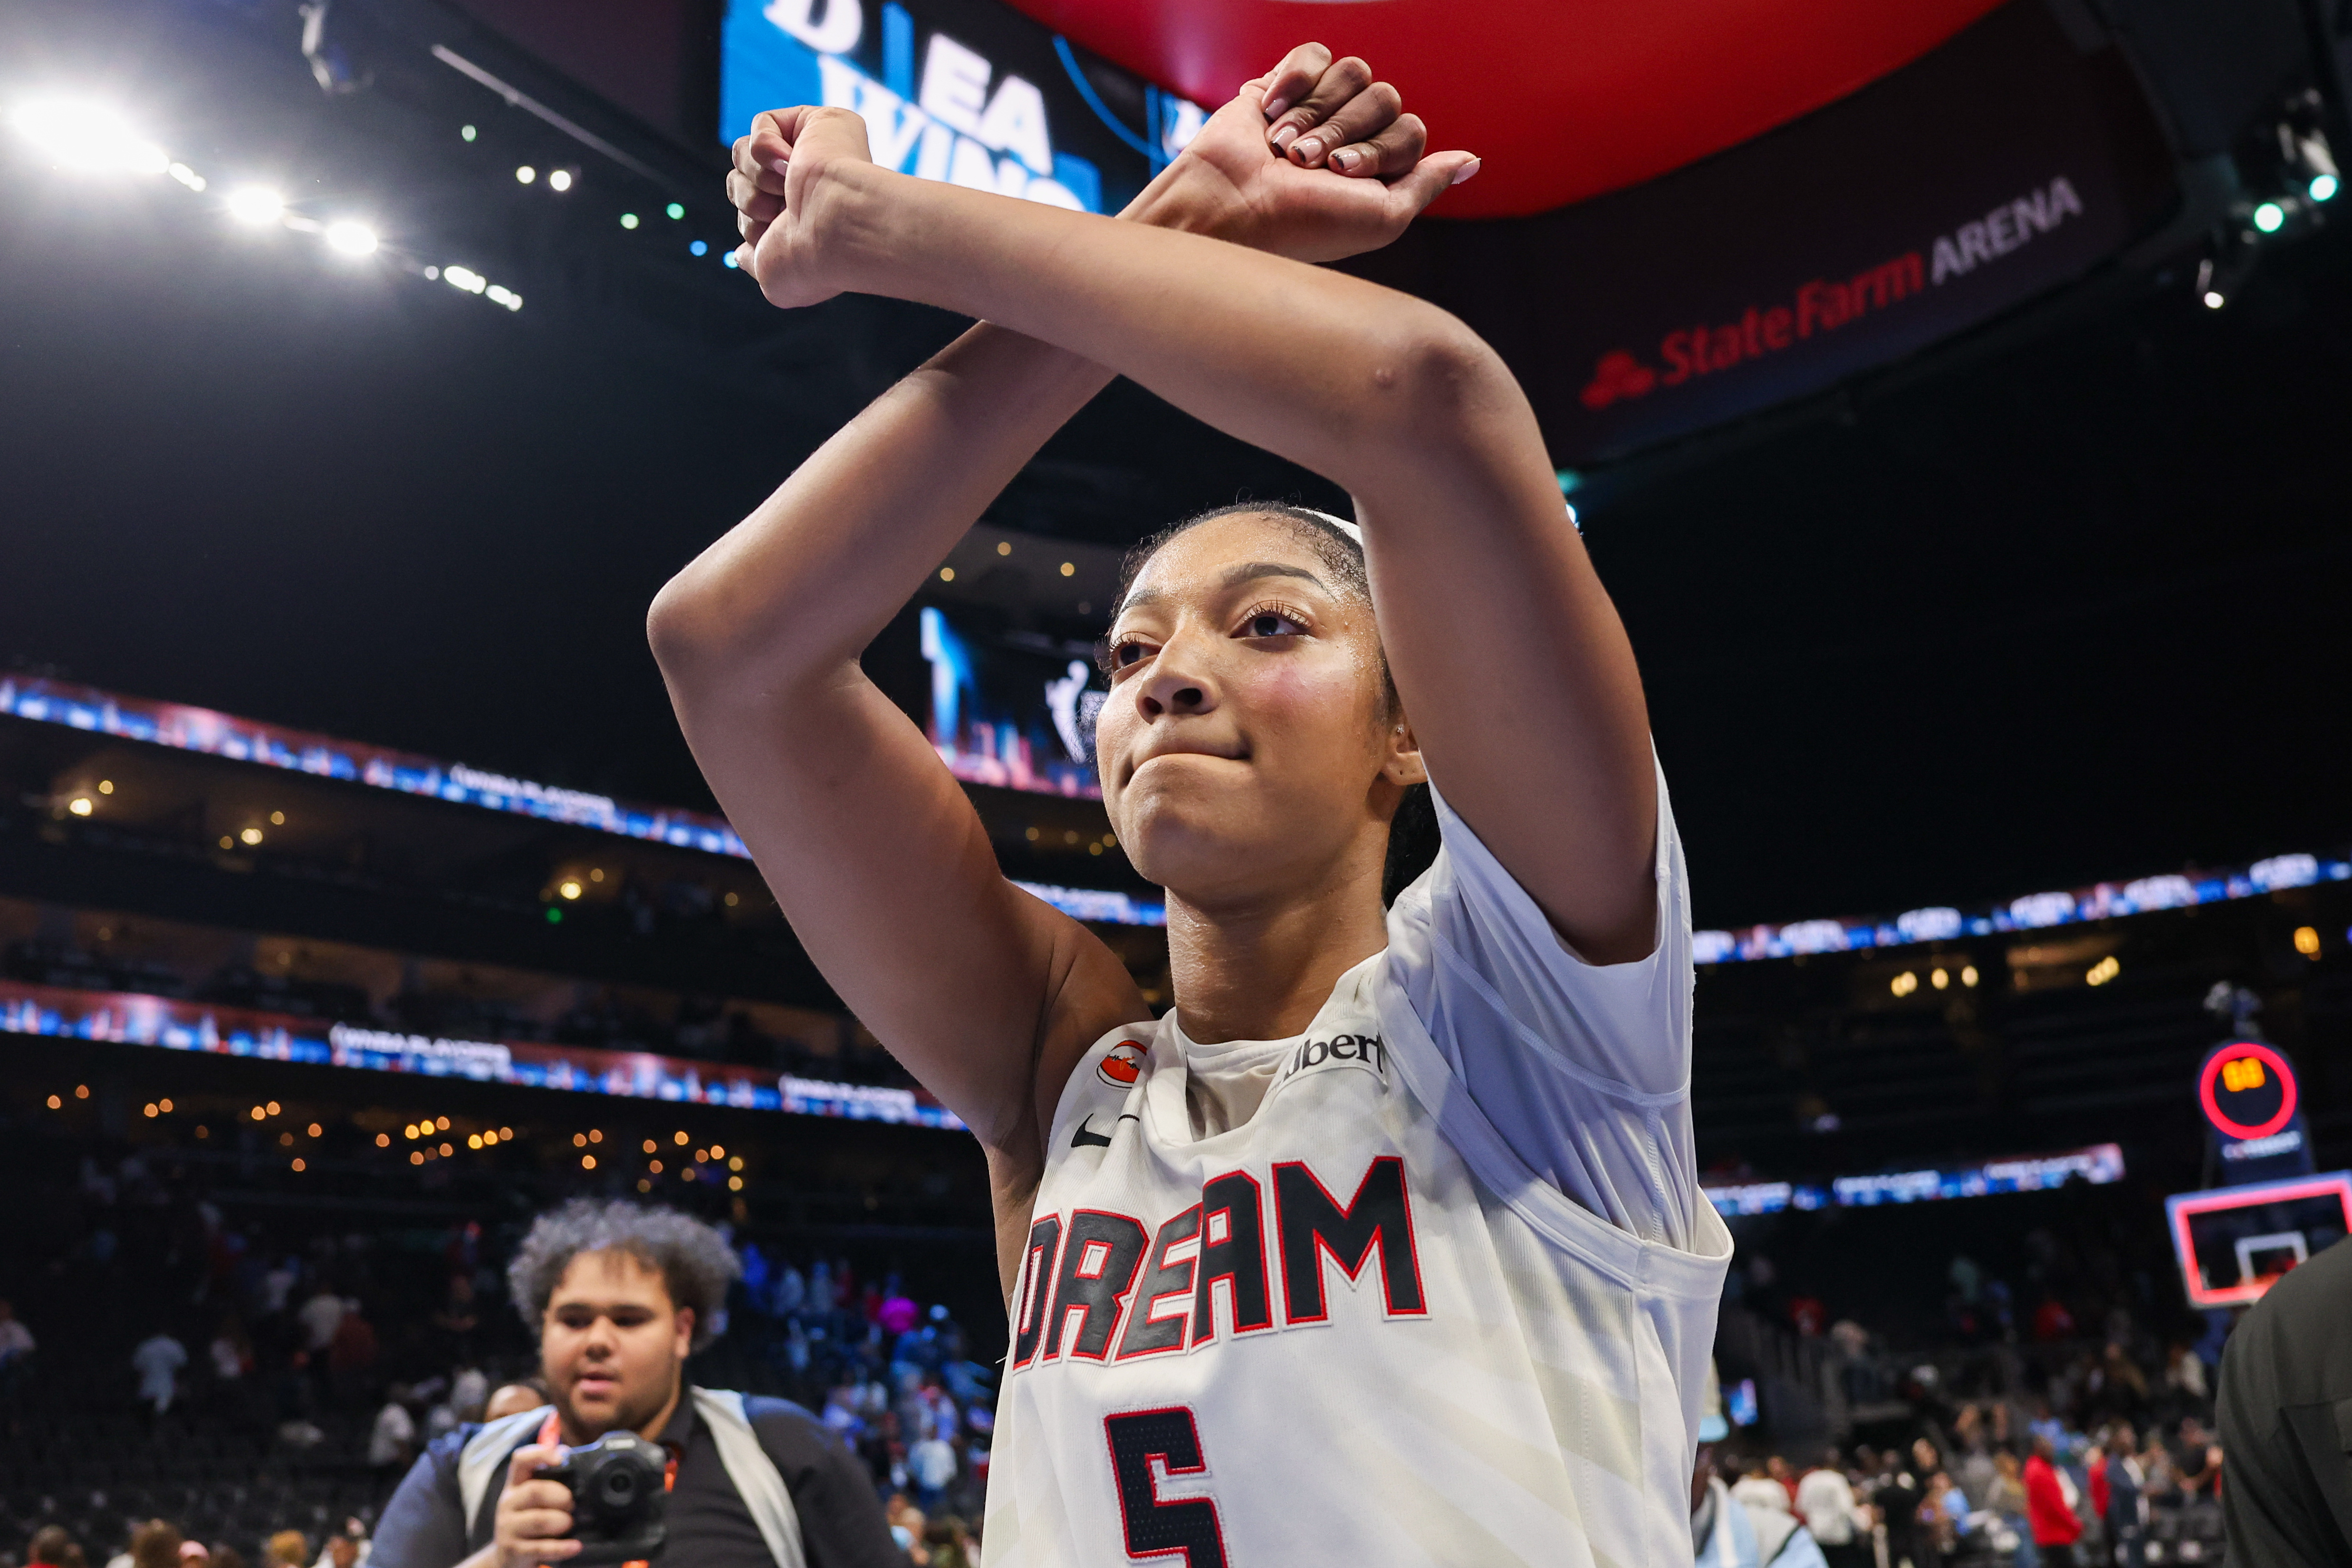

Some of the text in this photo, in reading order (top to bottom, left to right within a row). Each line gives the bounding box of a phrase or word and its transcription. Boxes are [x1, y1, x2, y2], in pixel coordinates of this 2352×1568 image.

[1930, 175, 2083, 285] ARENA
[1012, 1155, 1429, 1372] DREAM
[1104, 1405, 1229, 1568] 5
